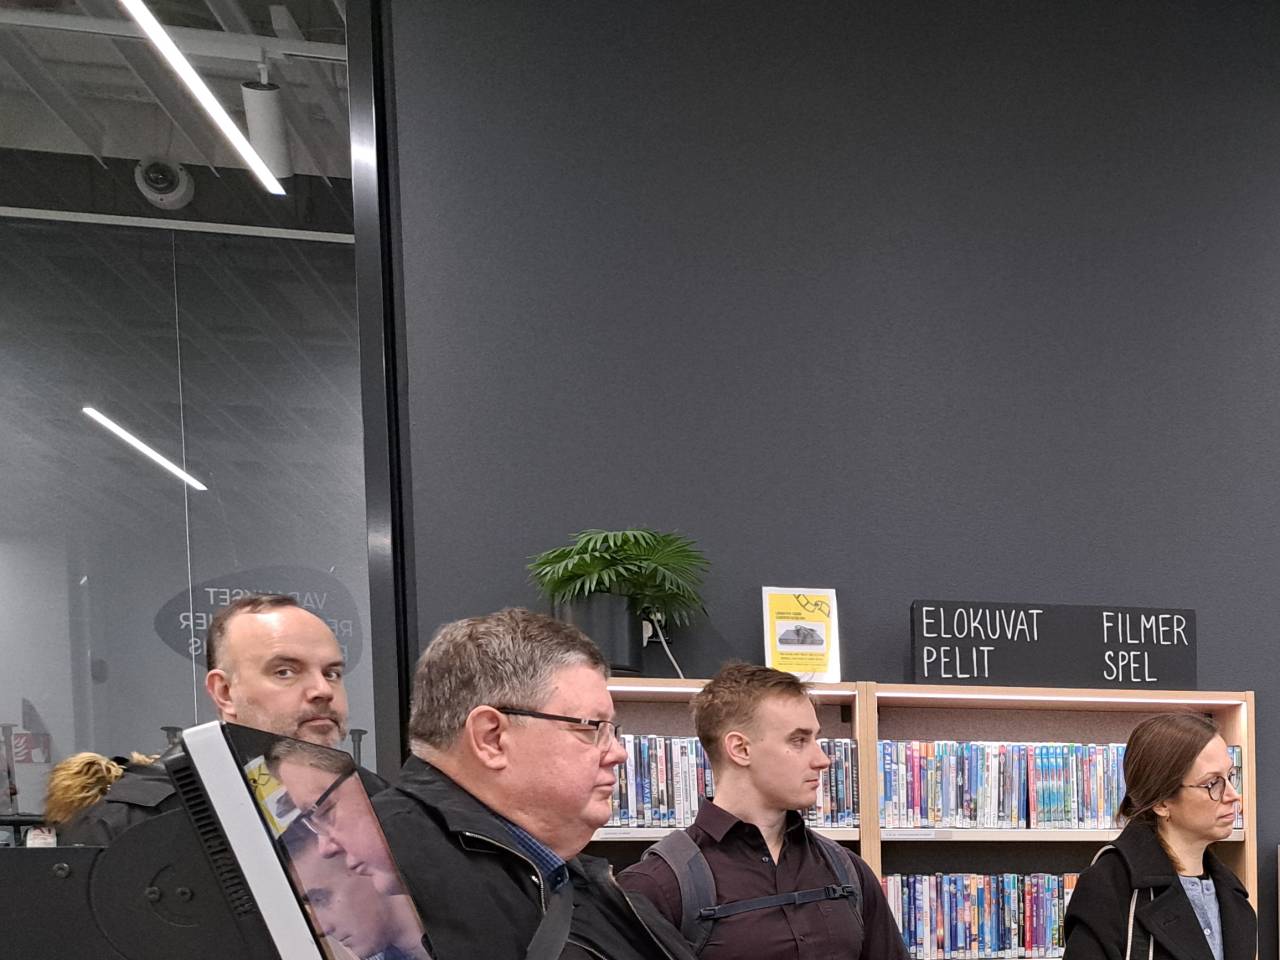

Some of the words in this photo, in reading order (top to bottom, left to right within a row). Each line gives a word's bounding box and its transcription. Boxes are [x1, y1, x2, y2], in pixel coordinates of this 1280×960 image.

[922, 606, 1044, 642] ELOKUVAT
[1102, 611, 1189, 647] FILMER
[923, 646, 996, 679] PELIT
[1103, 650, 1158, 683] SPEL
